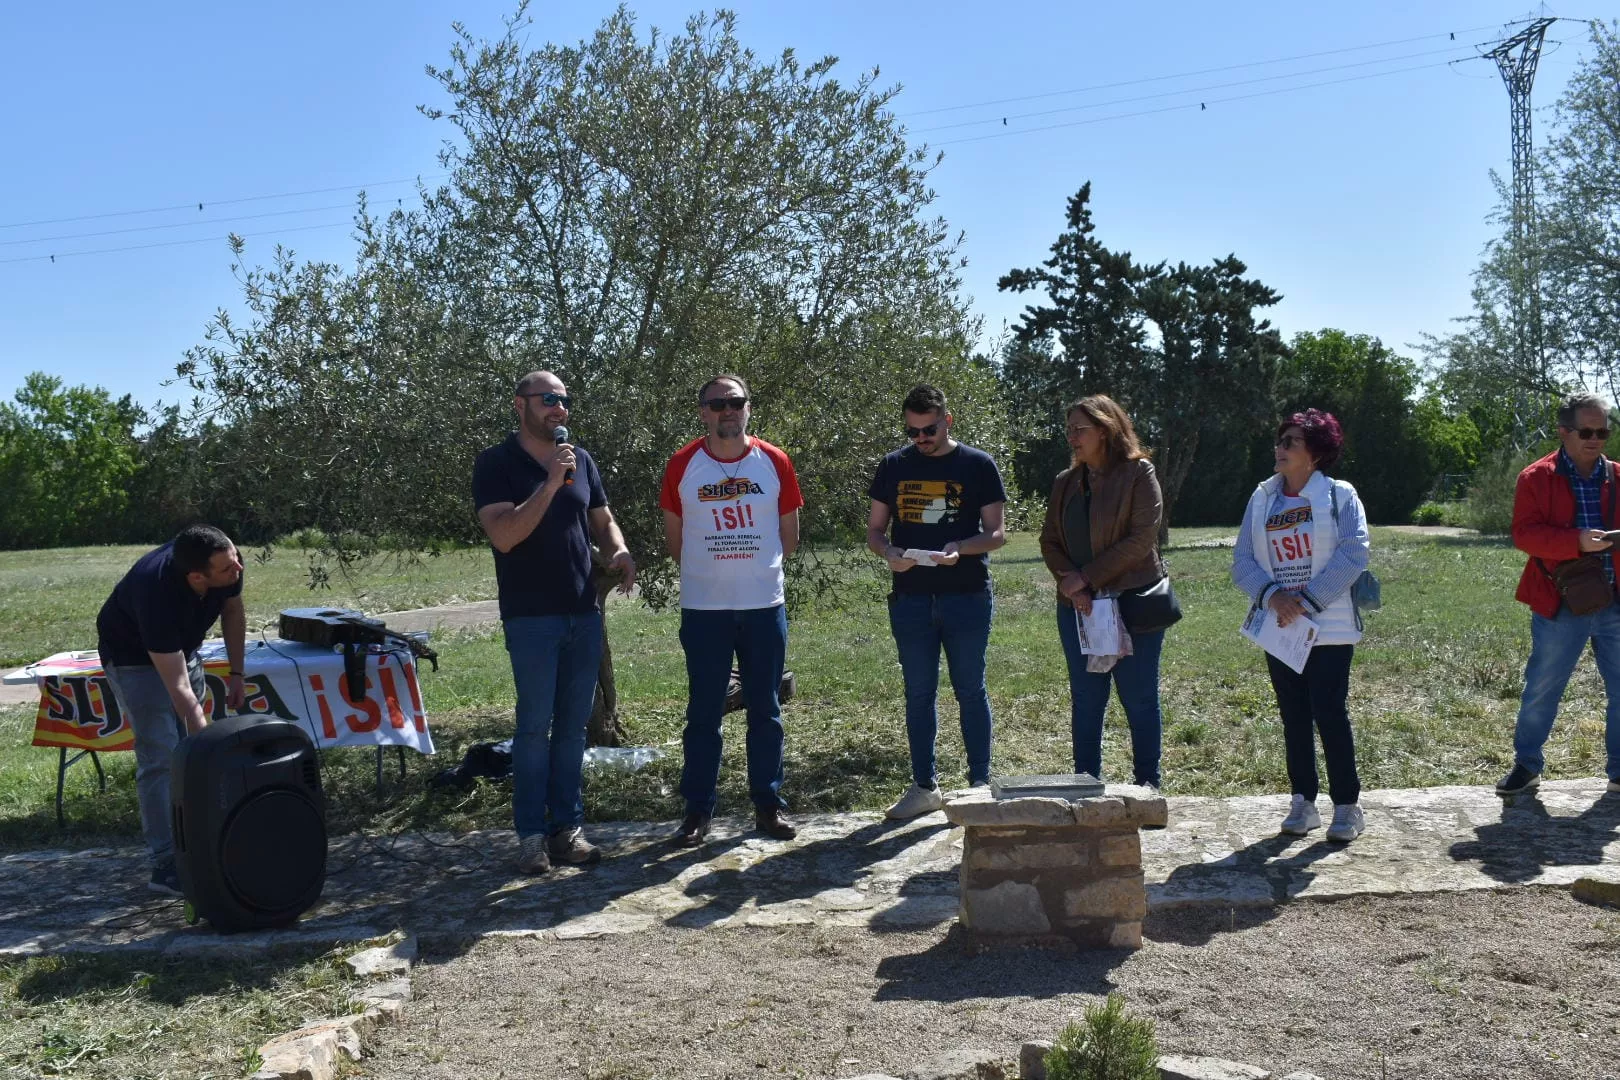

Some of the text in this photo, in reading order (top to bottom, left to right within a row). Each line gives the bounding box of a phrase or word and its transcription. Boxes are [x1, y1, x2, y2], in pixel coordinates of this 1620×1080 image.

[712, 500, 754, 531] ¡SÍ!
[1271, 528, 1312, 562] ¡SÍ!
[308, 655, 426, 739] ¡SÍ!
